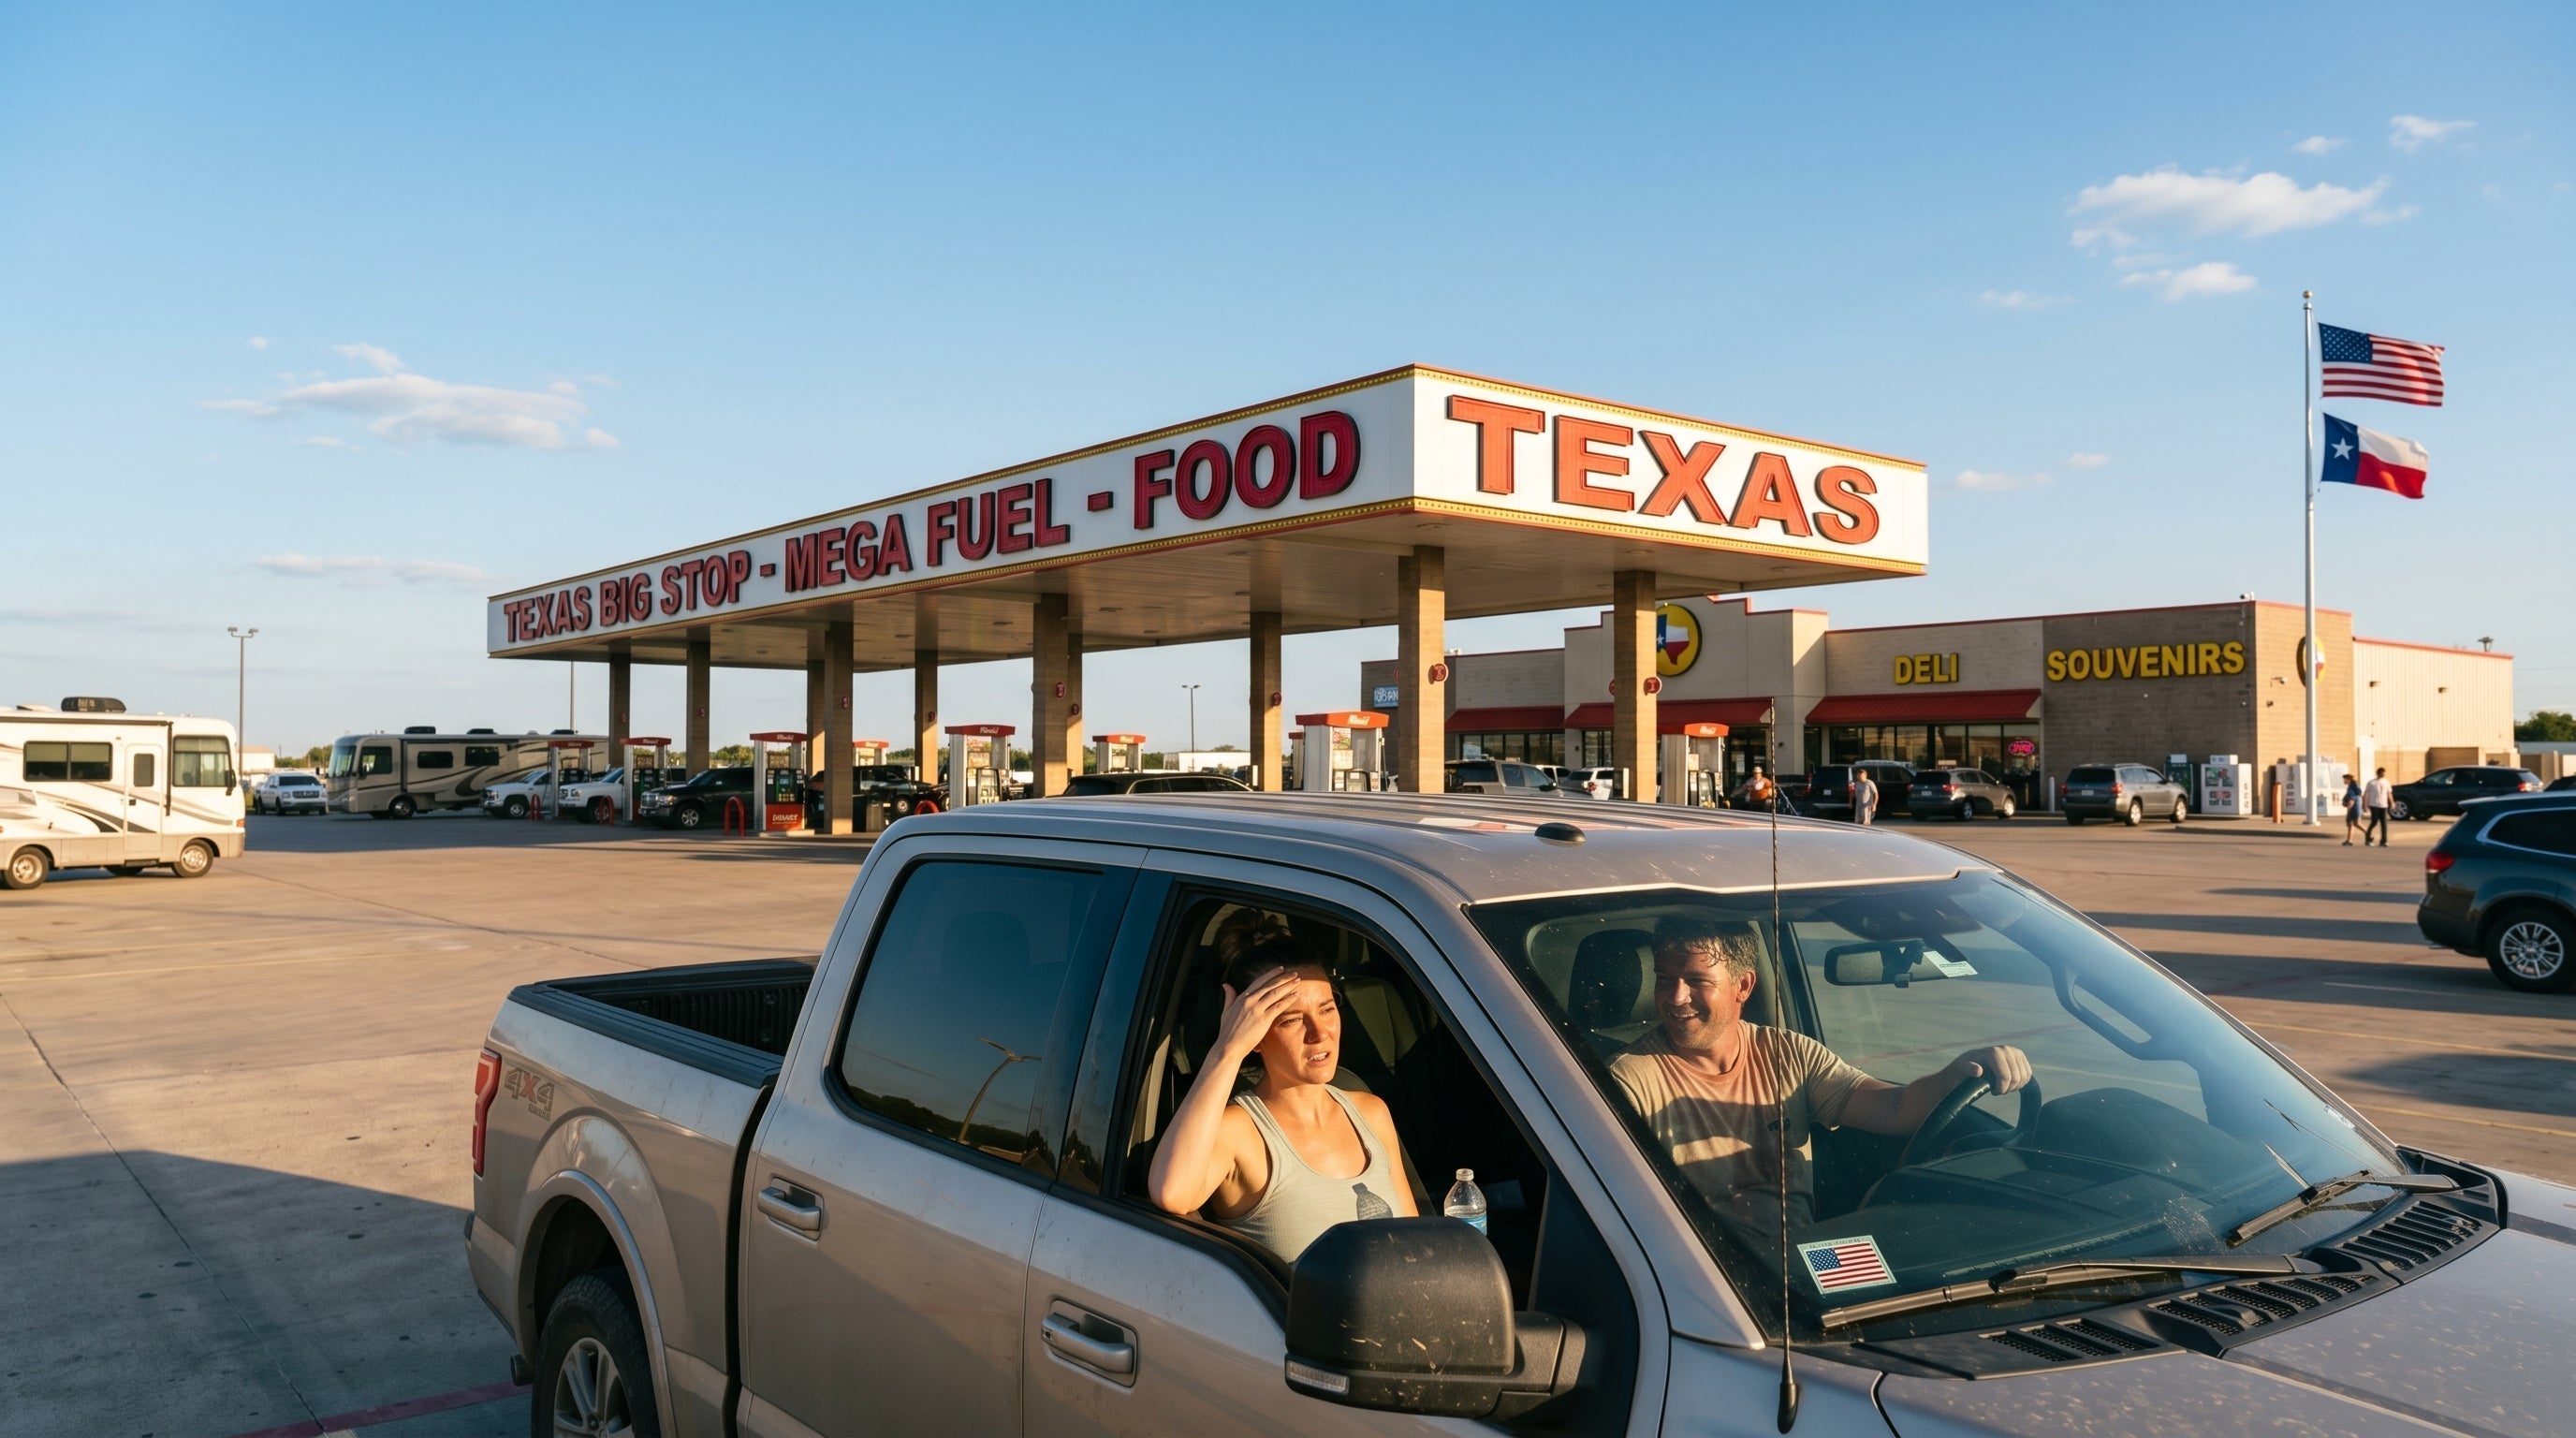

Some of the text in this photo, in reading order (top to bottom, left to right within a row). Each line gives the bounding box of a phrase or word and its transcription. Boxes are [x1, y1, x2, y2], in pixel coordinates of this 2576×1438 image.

[1447, 394, 1879, 543] TEXAS
[504, 410, 1361, 642] TEXAS BIG STOP - MEGA FUEL - FOOD
[1895, 653, 1958, 684] DELI
[2047, 640, 2245, 681] SOUVENIRS
